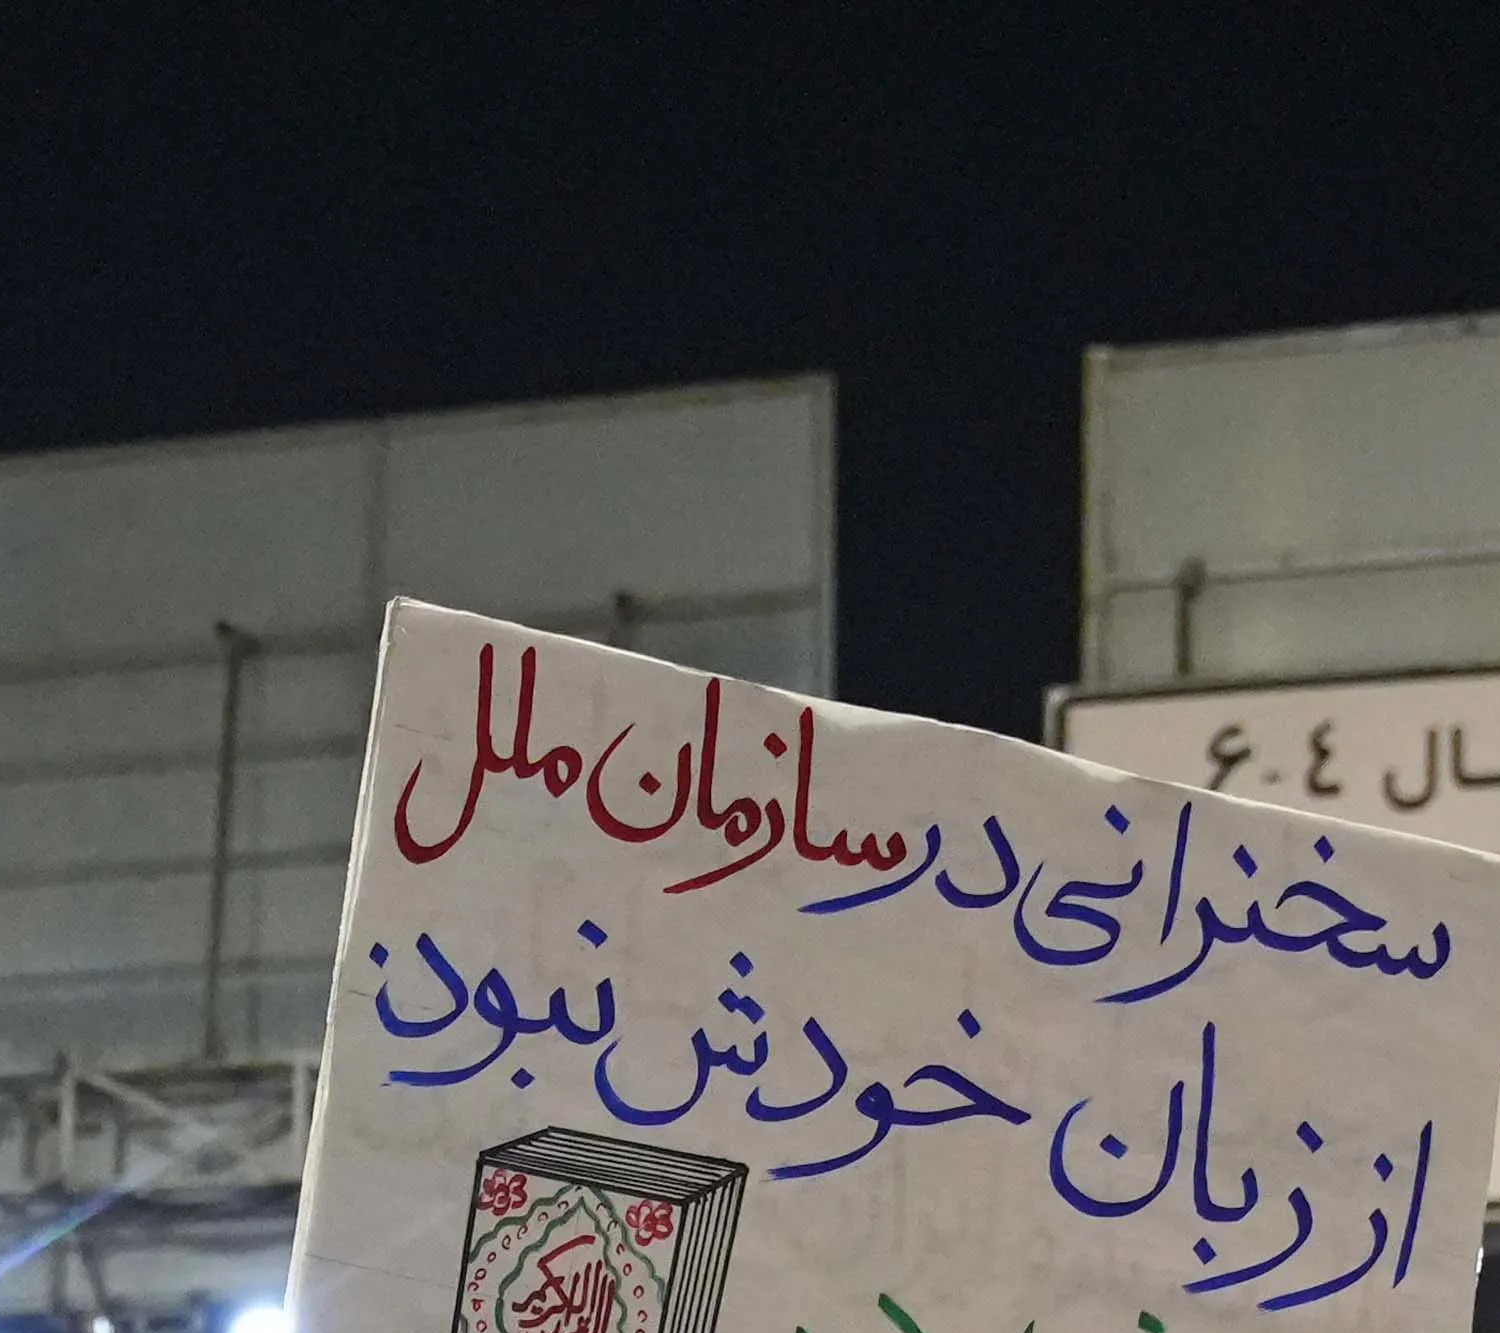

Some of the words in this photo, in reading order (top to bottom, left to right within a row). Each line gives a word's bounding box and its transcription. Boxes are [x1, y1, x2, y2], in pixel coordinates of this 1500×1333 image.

[395, 643, 583, 865] ملل
[587, 678, 907, 894] سازمان
[803, 815, 1020, 914] در
[1014, 803, 1451, 1004] سخنرانی
[595, 952, 1032, 1181] خودش
[1050, 1022, 1323, 1293] زبان
[1261, 1122, 1432, 1311] از
